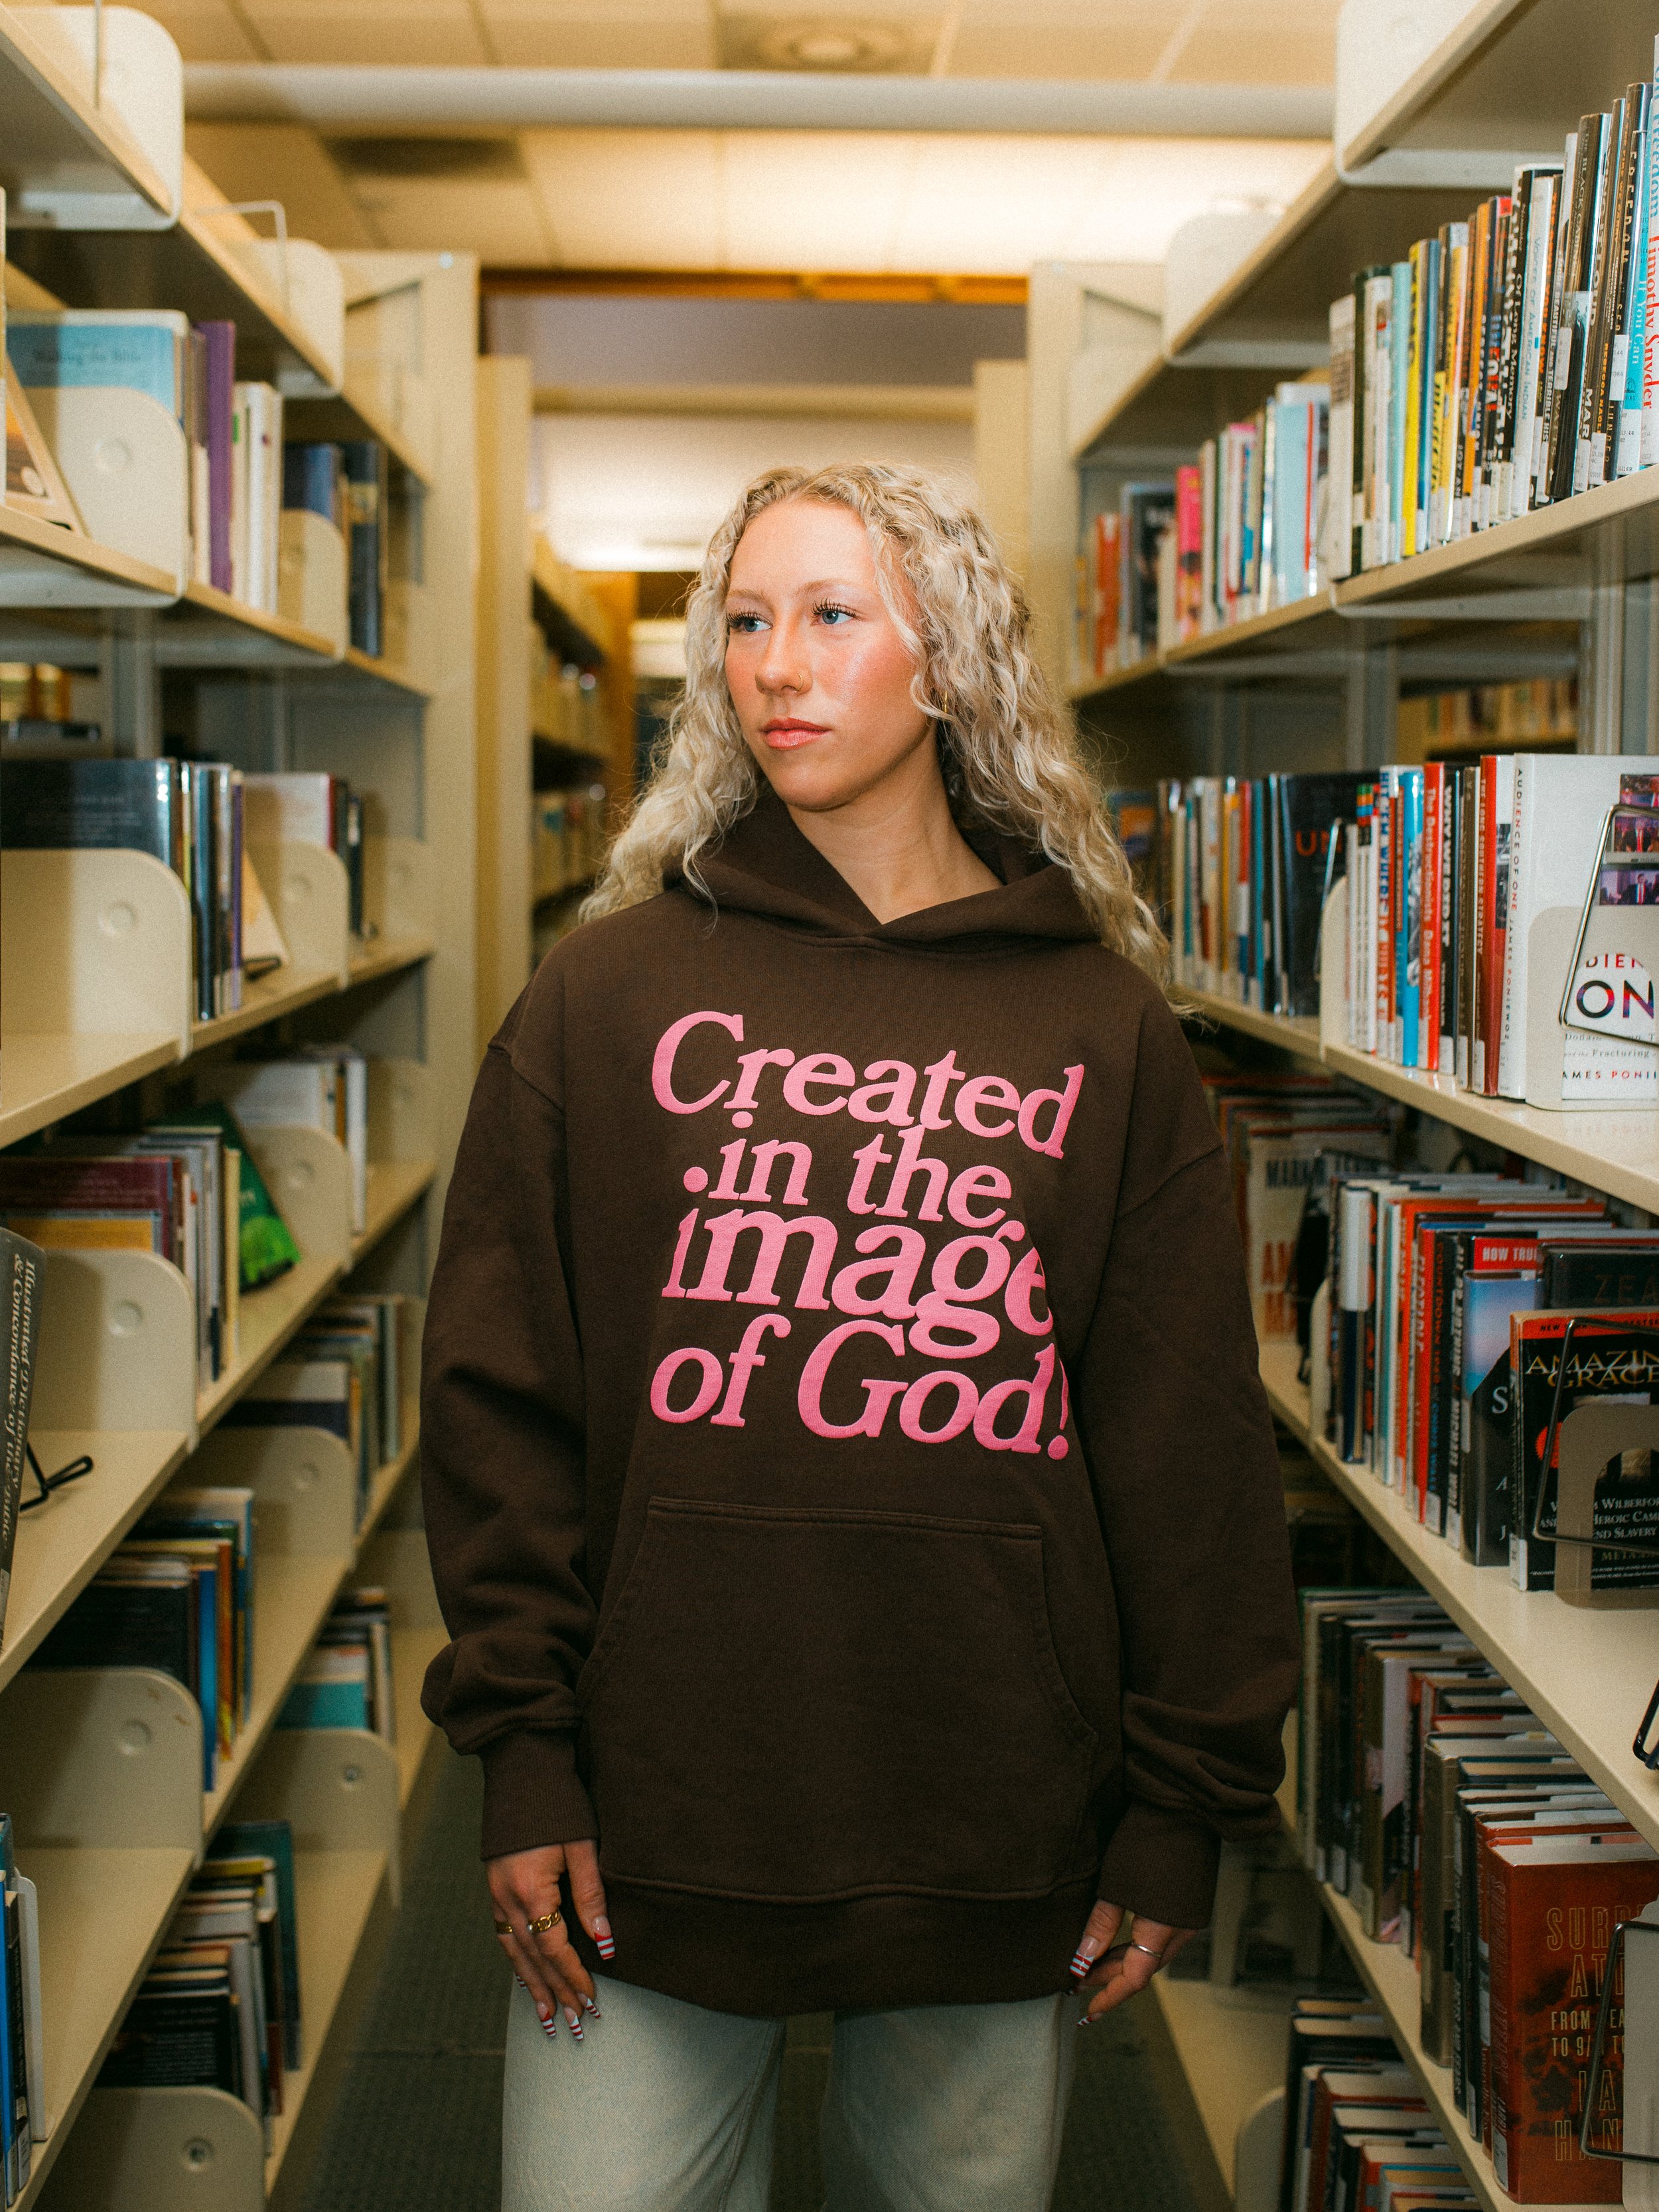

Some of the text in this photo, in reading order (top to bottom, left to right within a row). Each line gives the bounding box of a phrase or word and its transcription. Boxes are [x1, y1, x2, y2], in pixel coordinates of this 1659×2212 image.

[1524, 312, 1536, 376] AMERICAN
[1632, 333, 1644, 364] Can
[1506, 348, 1518, 419] Memory
[1600, 342, 1609, 397] REBECCA
[1642, 334, 1659, 409] Snyder
[1522, 382, 1532, 420] INDIAN
[1544, 369, 1554, 420] TERRIBLE
[1581, 388, 1593, 439] MAR
[1427, 787, 1437, 813] The
[1514, 769, 1523, 848] AUDIENCE
[1513, 855, 1520, 875] OF
[1423, 930, 1434, 966] Dana
[1576, 980, 1654, 1019] ON
[1592, 1049, 1650, 1059] Fracturing
[652, 1011, 1084, 1159] Created
[1562, 1070, 1601, 1080] AMES
[707, 1110, 1012, 1228] in the
[15, 1254, 25, 1278] &
[662, 1166, 1054, 1359] image
[1482, 1247, 1538, 1262] HOW TRU
[1434, 1241, 1445, 1345] COUNTDOWN
[9, 1278, 23, 1410] Concordance
[1525, 1349, 1659, 1374] AMAZIN
[12, 1260, 36, 1489] Illustrated Dictionary
[650, 1313, 792, 1427] of
[4, 1412, 16, 1436] of
[1614, 1526, 1657, 1539] SLAVERY
[1551, 2010, 1591, 2030] FROM
[1551, 2035, 1569, 2057] TO
